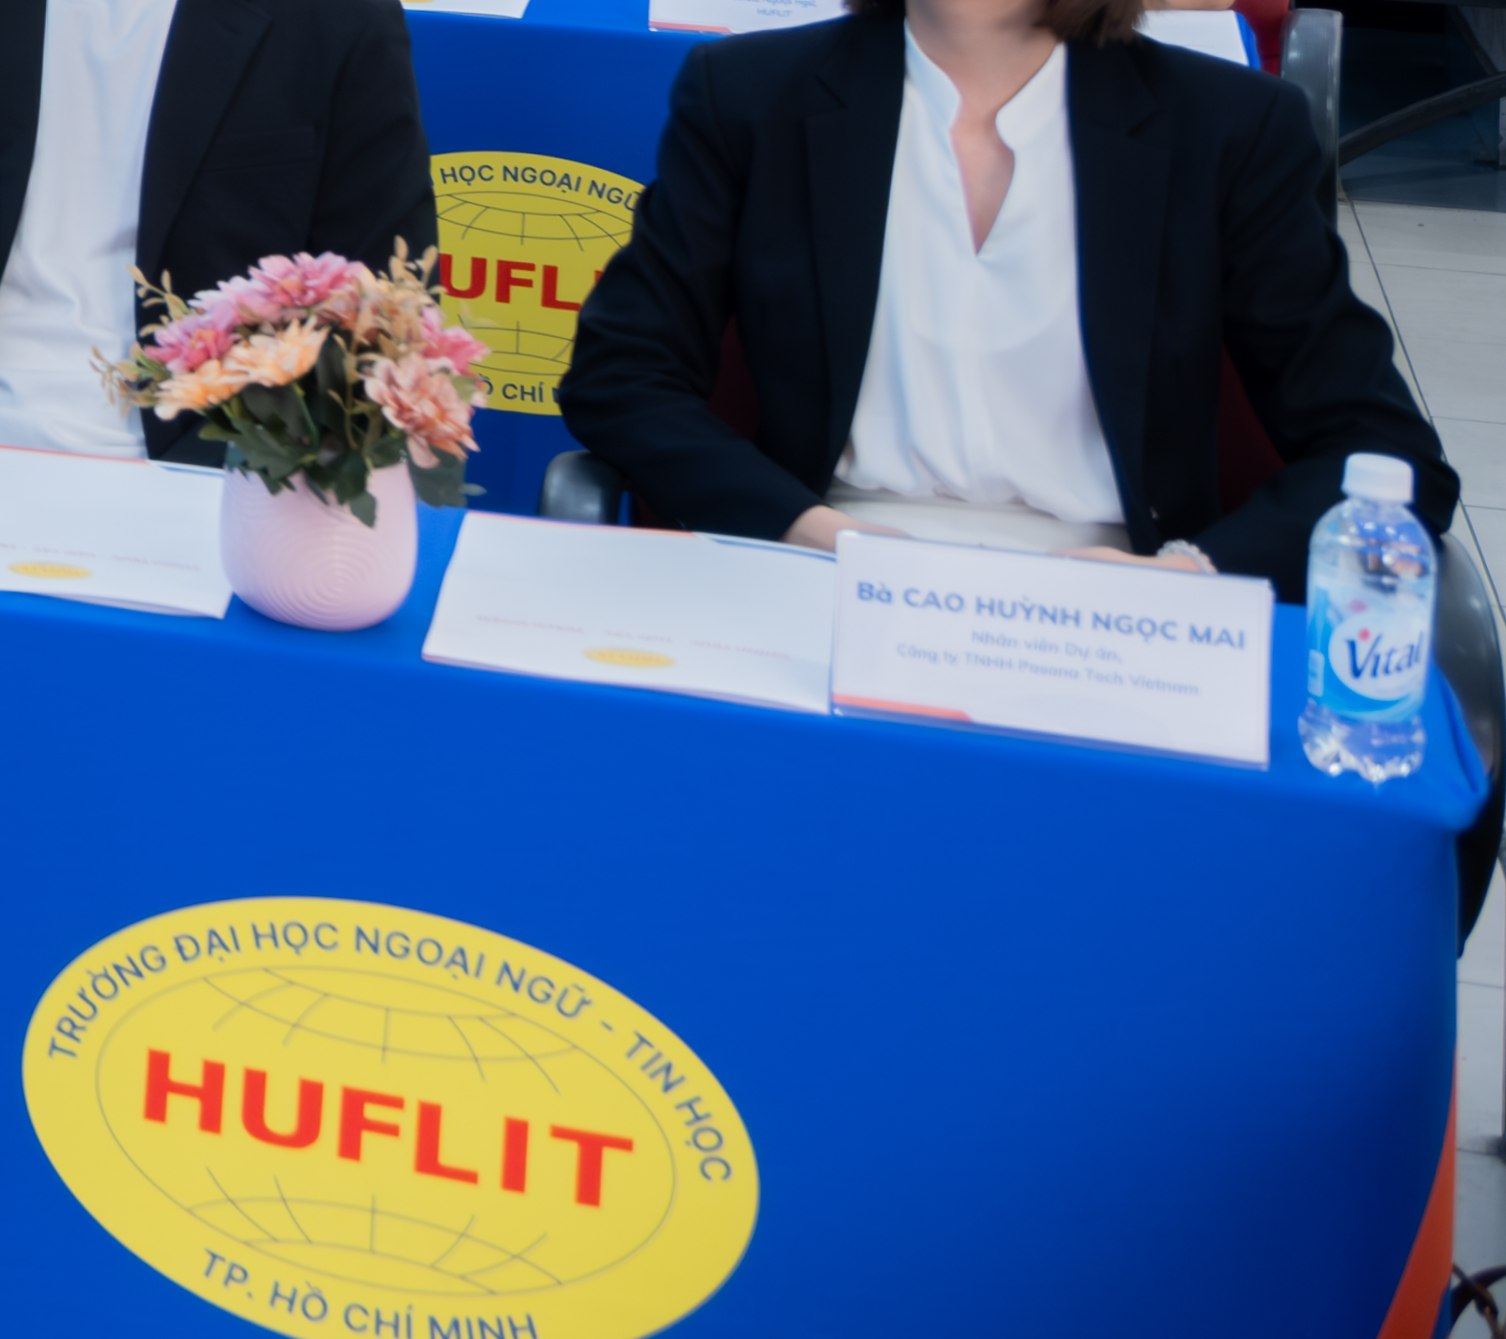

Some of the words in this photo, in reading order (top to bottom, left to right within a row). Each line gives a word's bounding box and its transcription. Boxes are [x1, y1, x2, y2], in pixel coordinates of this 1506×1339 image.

[857, 581, 893, 604] Bà
[903, 587, 965, 612] CAO
[975, 594, 1081, 629] HUỲNH
[1091, 611, 1178, 643] NGỌC
[1188, 625, 1246, 650] MAI
[1343, 628, 1427, 684] Vital
[47, 944, 169, 1063] TRƯỜNG
[173, 923, 242, 965] ĐẠI
[250, 919, 341, 958] HỌC
[354, 924, 488, 981] NGOẠI
[496, 960, 594, 1021] NGỮ
[623, 1031, 684, 1099] TIN
[674, 1096, 733, 1185] HỌC
[142, 1047, 634, 1209] HUFLIT
[201, 1247, 256, 1301] TP.
[268, 1279, 330, 1323] HỒ
